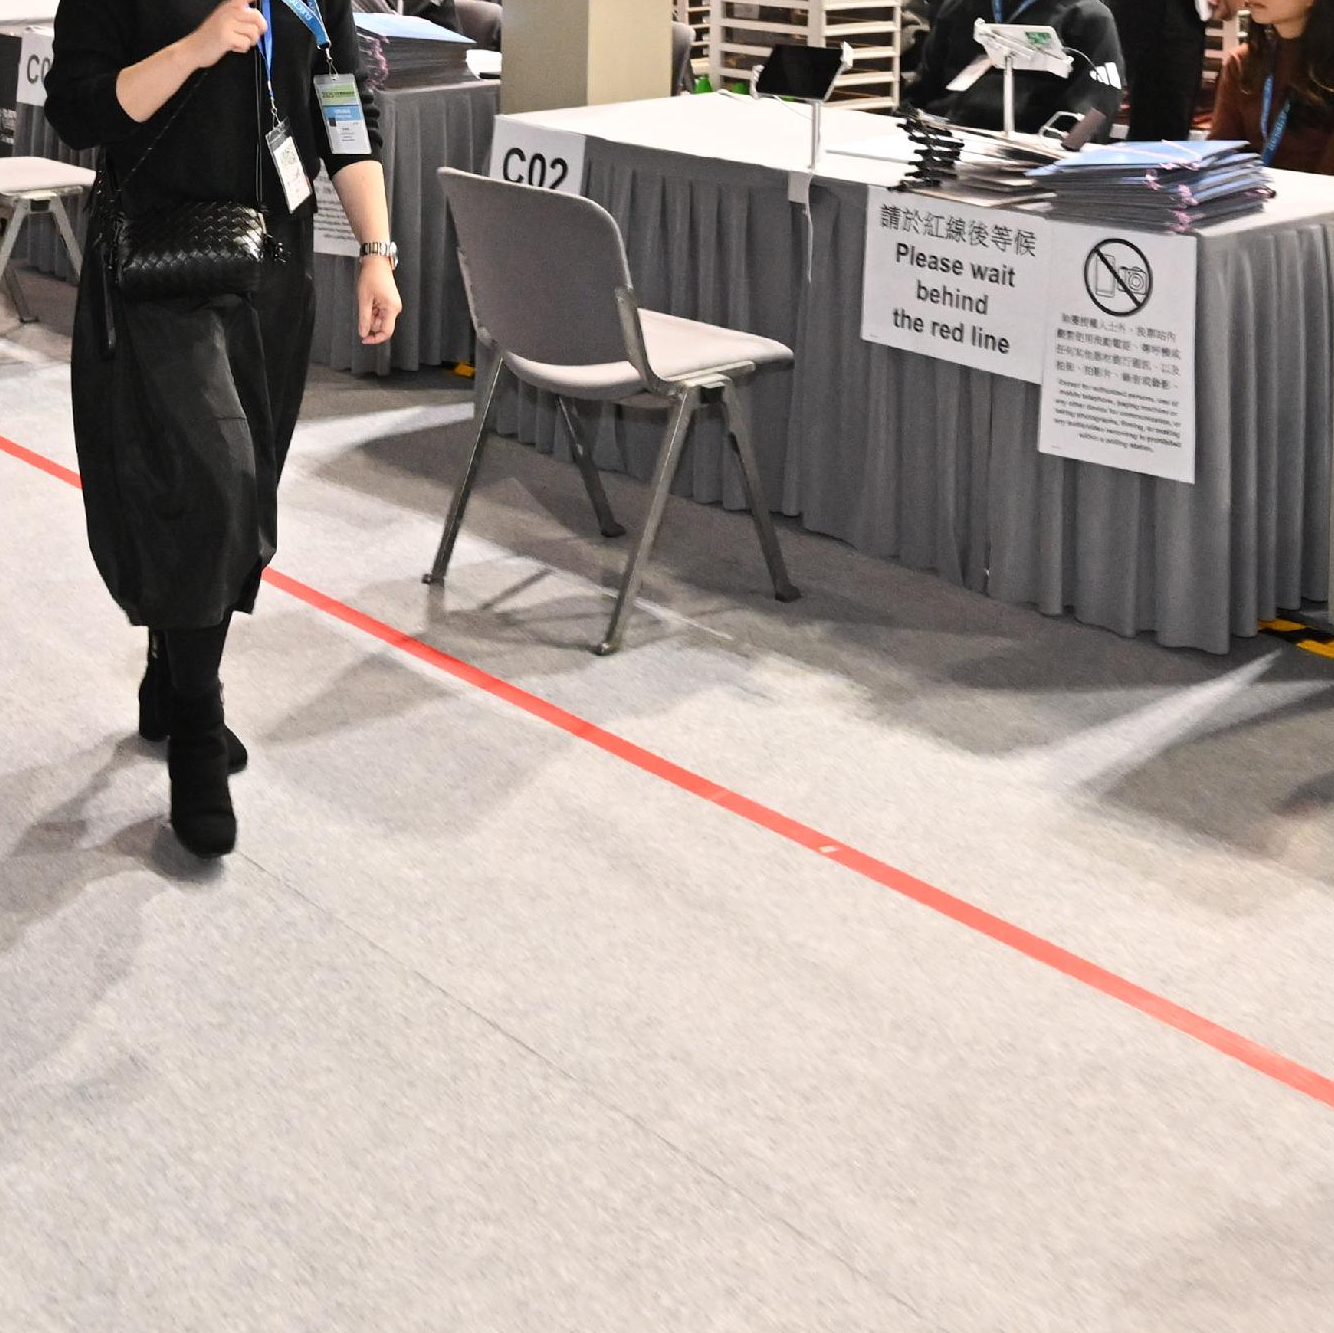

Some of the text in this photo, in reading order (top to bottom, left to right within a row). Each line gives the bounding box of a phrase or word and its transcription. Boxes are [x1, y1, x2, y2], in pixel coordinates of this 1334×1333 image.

[26, 54, 52, 84] C0
[503, 147, 569, 190] C02
[880, 203, 1036, 257] 請於紅線後等候
[895, 242, 1016, 288] Please wait
[916, 279, 989, 316] behind
[892, 307, 1010, 355] the red line
